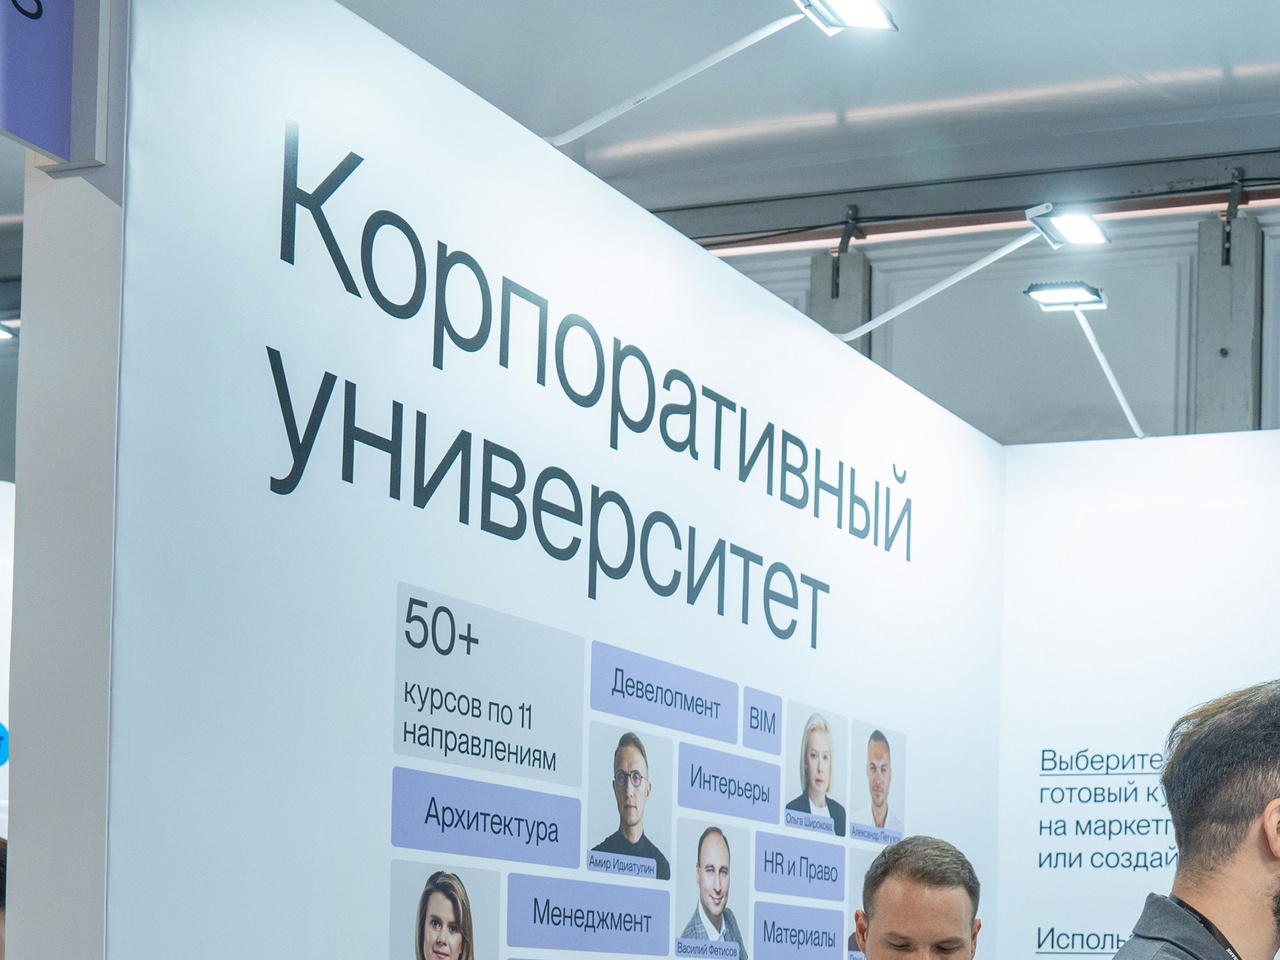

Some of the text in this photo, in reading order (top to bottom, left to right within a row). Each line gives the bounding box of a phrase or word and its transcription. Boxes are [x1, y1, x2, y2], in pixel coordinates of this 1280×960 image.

[278, 116, 915, 561] Корпоративный
[266, 345, 830, 649] университет
[404, 597, 479, 656] 50+
[404, 681, 532, 730] курсов по 11
[611, 667, 721, 719] Девелопмент
[750, 706, 776, 735] BIM
[403, 721, 557, 771] направлениям
[1040, 749, 1163, 774] Выберите
[690, 763, 770, 803] Интерьеры
[1039, 781, 1138, 804] готовый
[424, 796, 559, 846] Архитектура
[785, 813, 832, 833] Ольга Широкова
[851, 826, 880, 842] Александр
[1039, 820, 1067, 836] на
[588, 855, 655, 875] Амир Идиатулин
[763, 851, 838, 883] HR и Право
[1038, 846, 1178, 872] или создай
[533, 898, 652, 933] Менеджмент
[763, 920, 835, 949] Материалы
[1037, 927, 1130, 950] Исполь
[677, 941, 738, 958] Василий Фетисов
